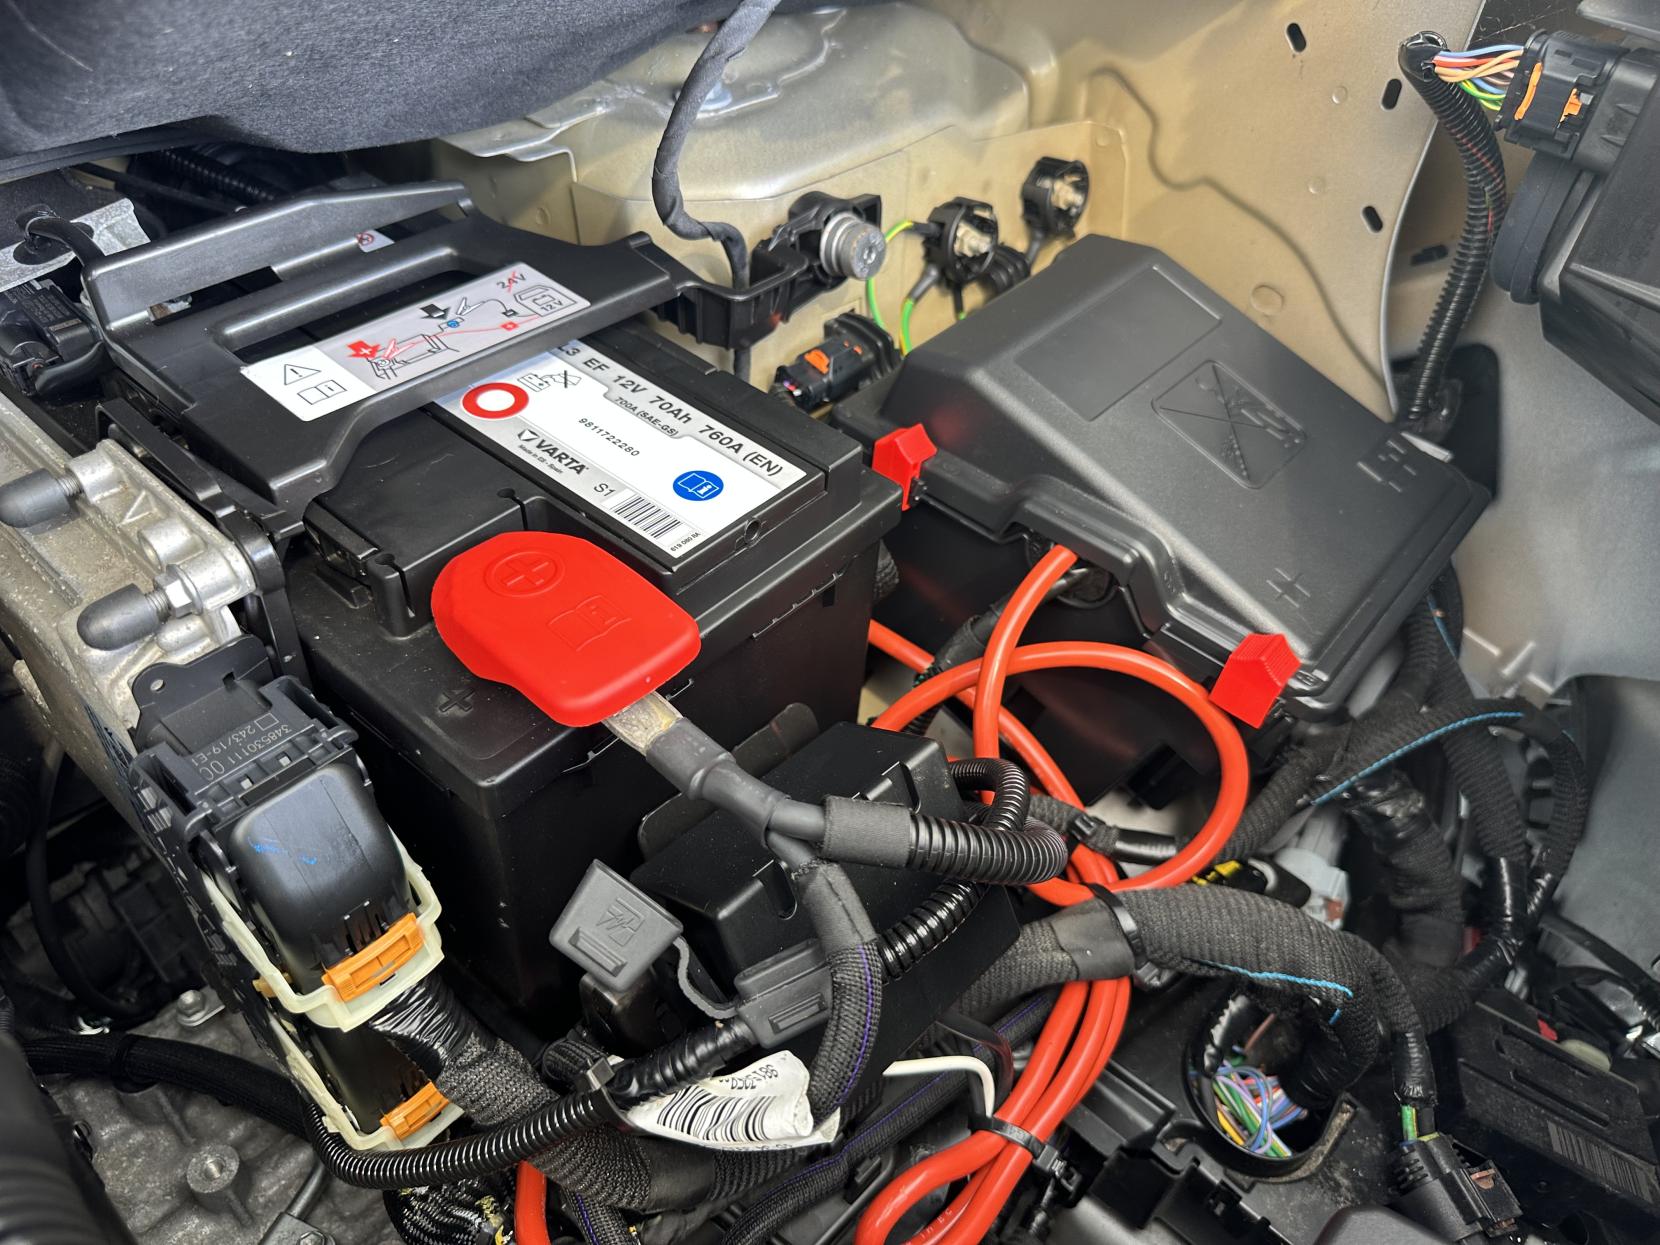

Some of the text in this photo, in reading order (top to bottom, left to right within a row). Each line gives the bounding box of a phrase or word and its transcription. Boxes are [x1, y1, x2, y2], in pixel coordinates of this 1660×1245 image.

[582, 358, 610, 371] EF
[612, 375, 648, 394] 12V
[650, 396, 692, 424] 70Ah
[699, 425, 744, 454] 760A
[743, 451, 783, 477] (EN)
[615, 396, 679, 437] 700A (SAE-GS)
[536, 439, 586, 475] VARTA
[579, 417, 640, 457] 9811722280
[594, 482, 616, 497] S1
[191, 725, 256, 767] 243/19-E1
[228, 724, 292, 764] 348530111
